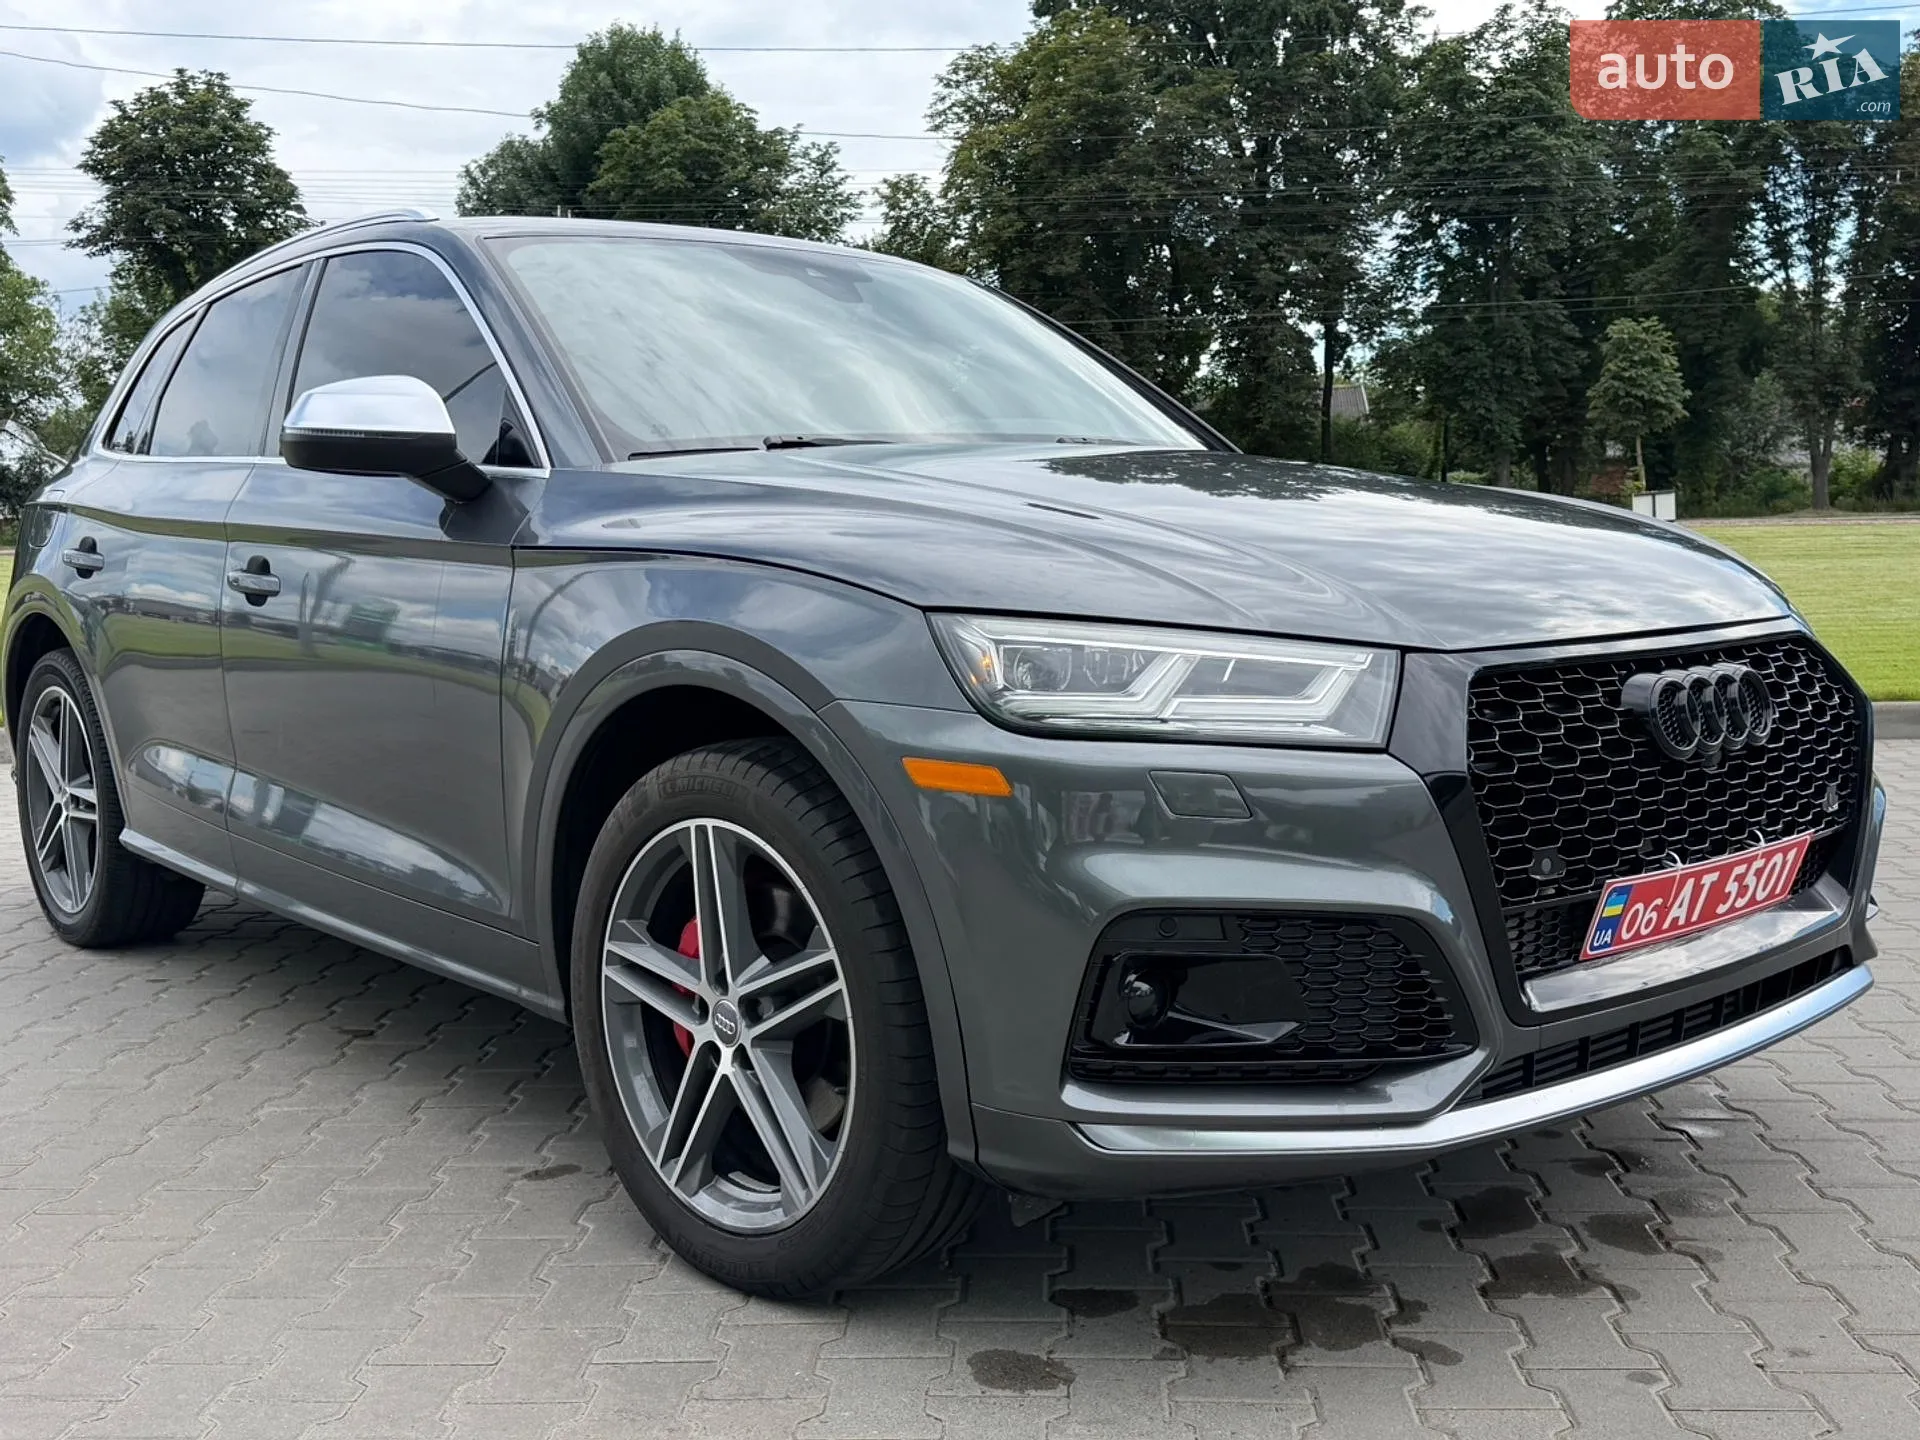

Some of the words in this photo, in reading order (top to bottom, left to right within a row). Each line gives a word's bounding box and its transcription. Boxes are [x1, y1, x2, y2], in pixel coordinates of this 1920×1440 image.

[1620, 898, 1663, 941] 06
[1662, 871, 1720, 930] AT
[1715, 847, 1799, 915] 5501
[1593, 928, 1613, 947] UA
